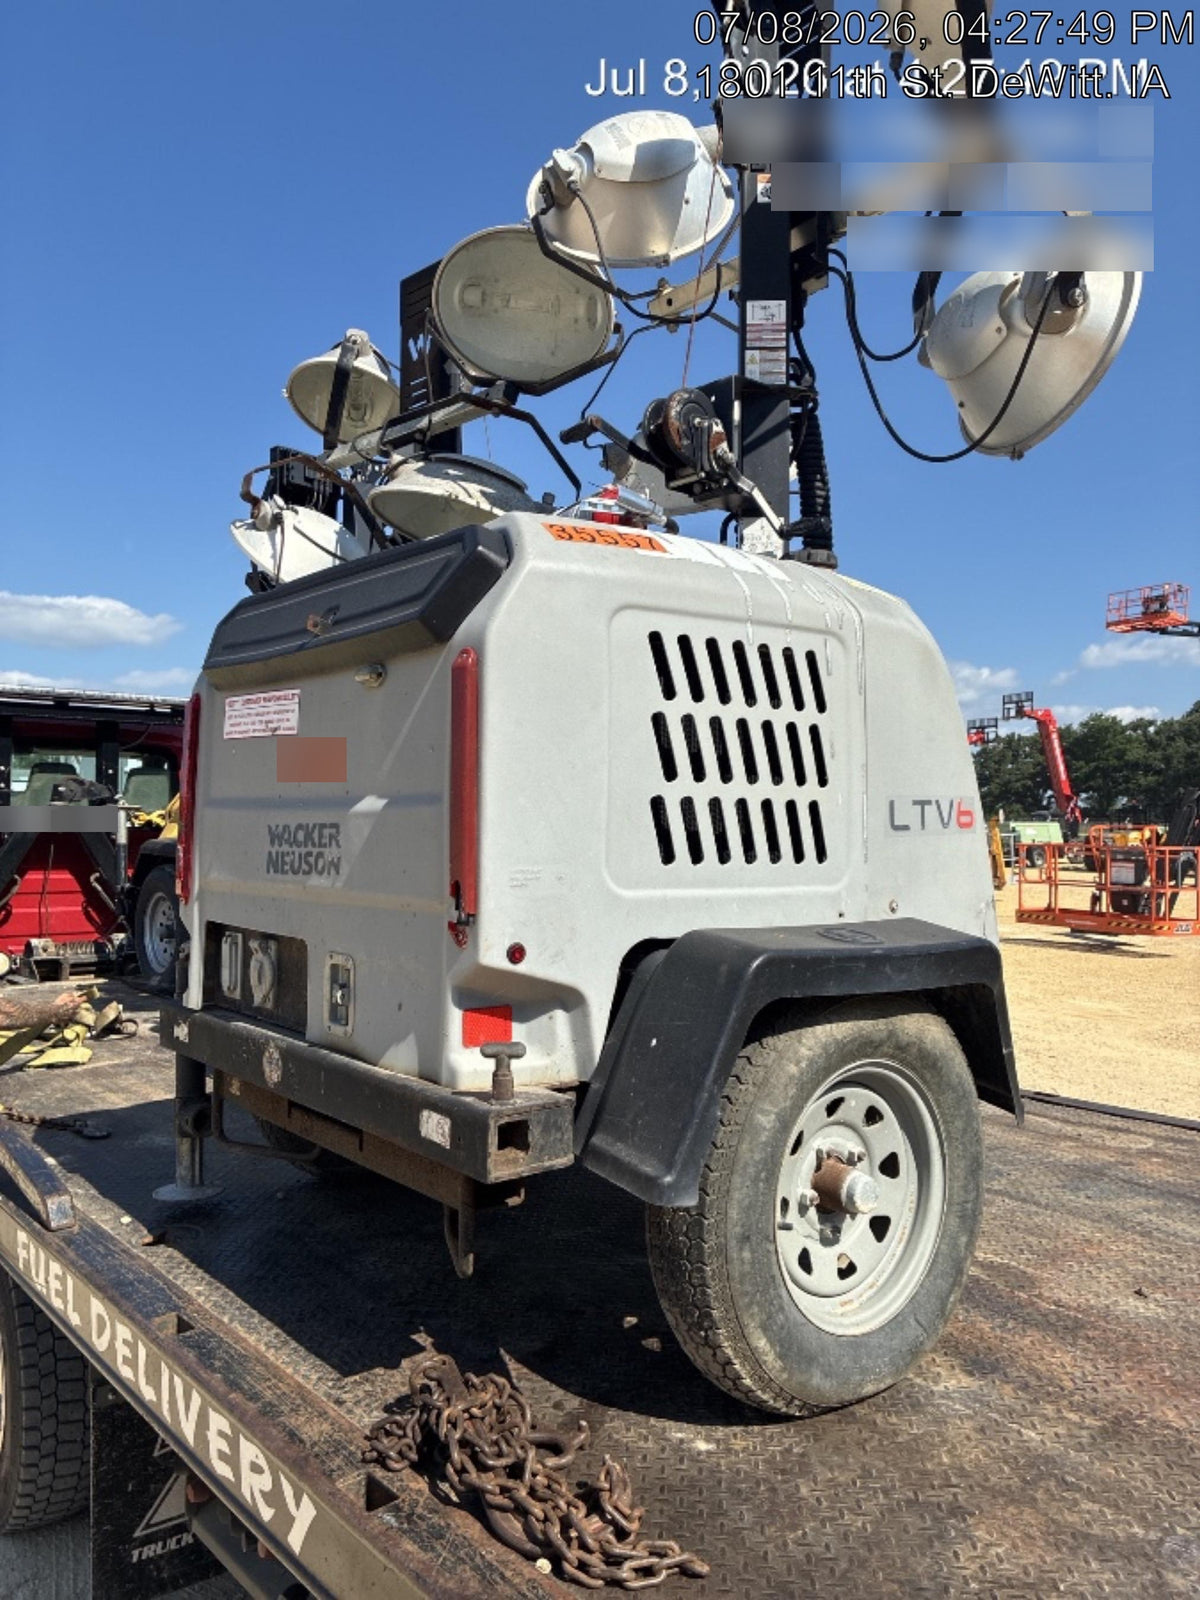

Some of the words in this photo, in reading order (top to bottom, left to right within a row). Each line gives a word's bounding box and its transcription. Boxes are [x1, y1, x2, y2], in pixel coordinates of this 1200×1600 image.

[549, 523, 657, 551] 35557
[889, 799, 974, 831] LTV6
[267, 822, 341, 848] WACKER
[266, 850, 341, 875] NEUSON
[16, 1229, 81, 1327] FUEL
[89, 1297, 317, 1556] DELIVERY
[131, 1532, 195, 1564] TRUCK
